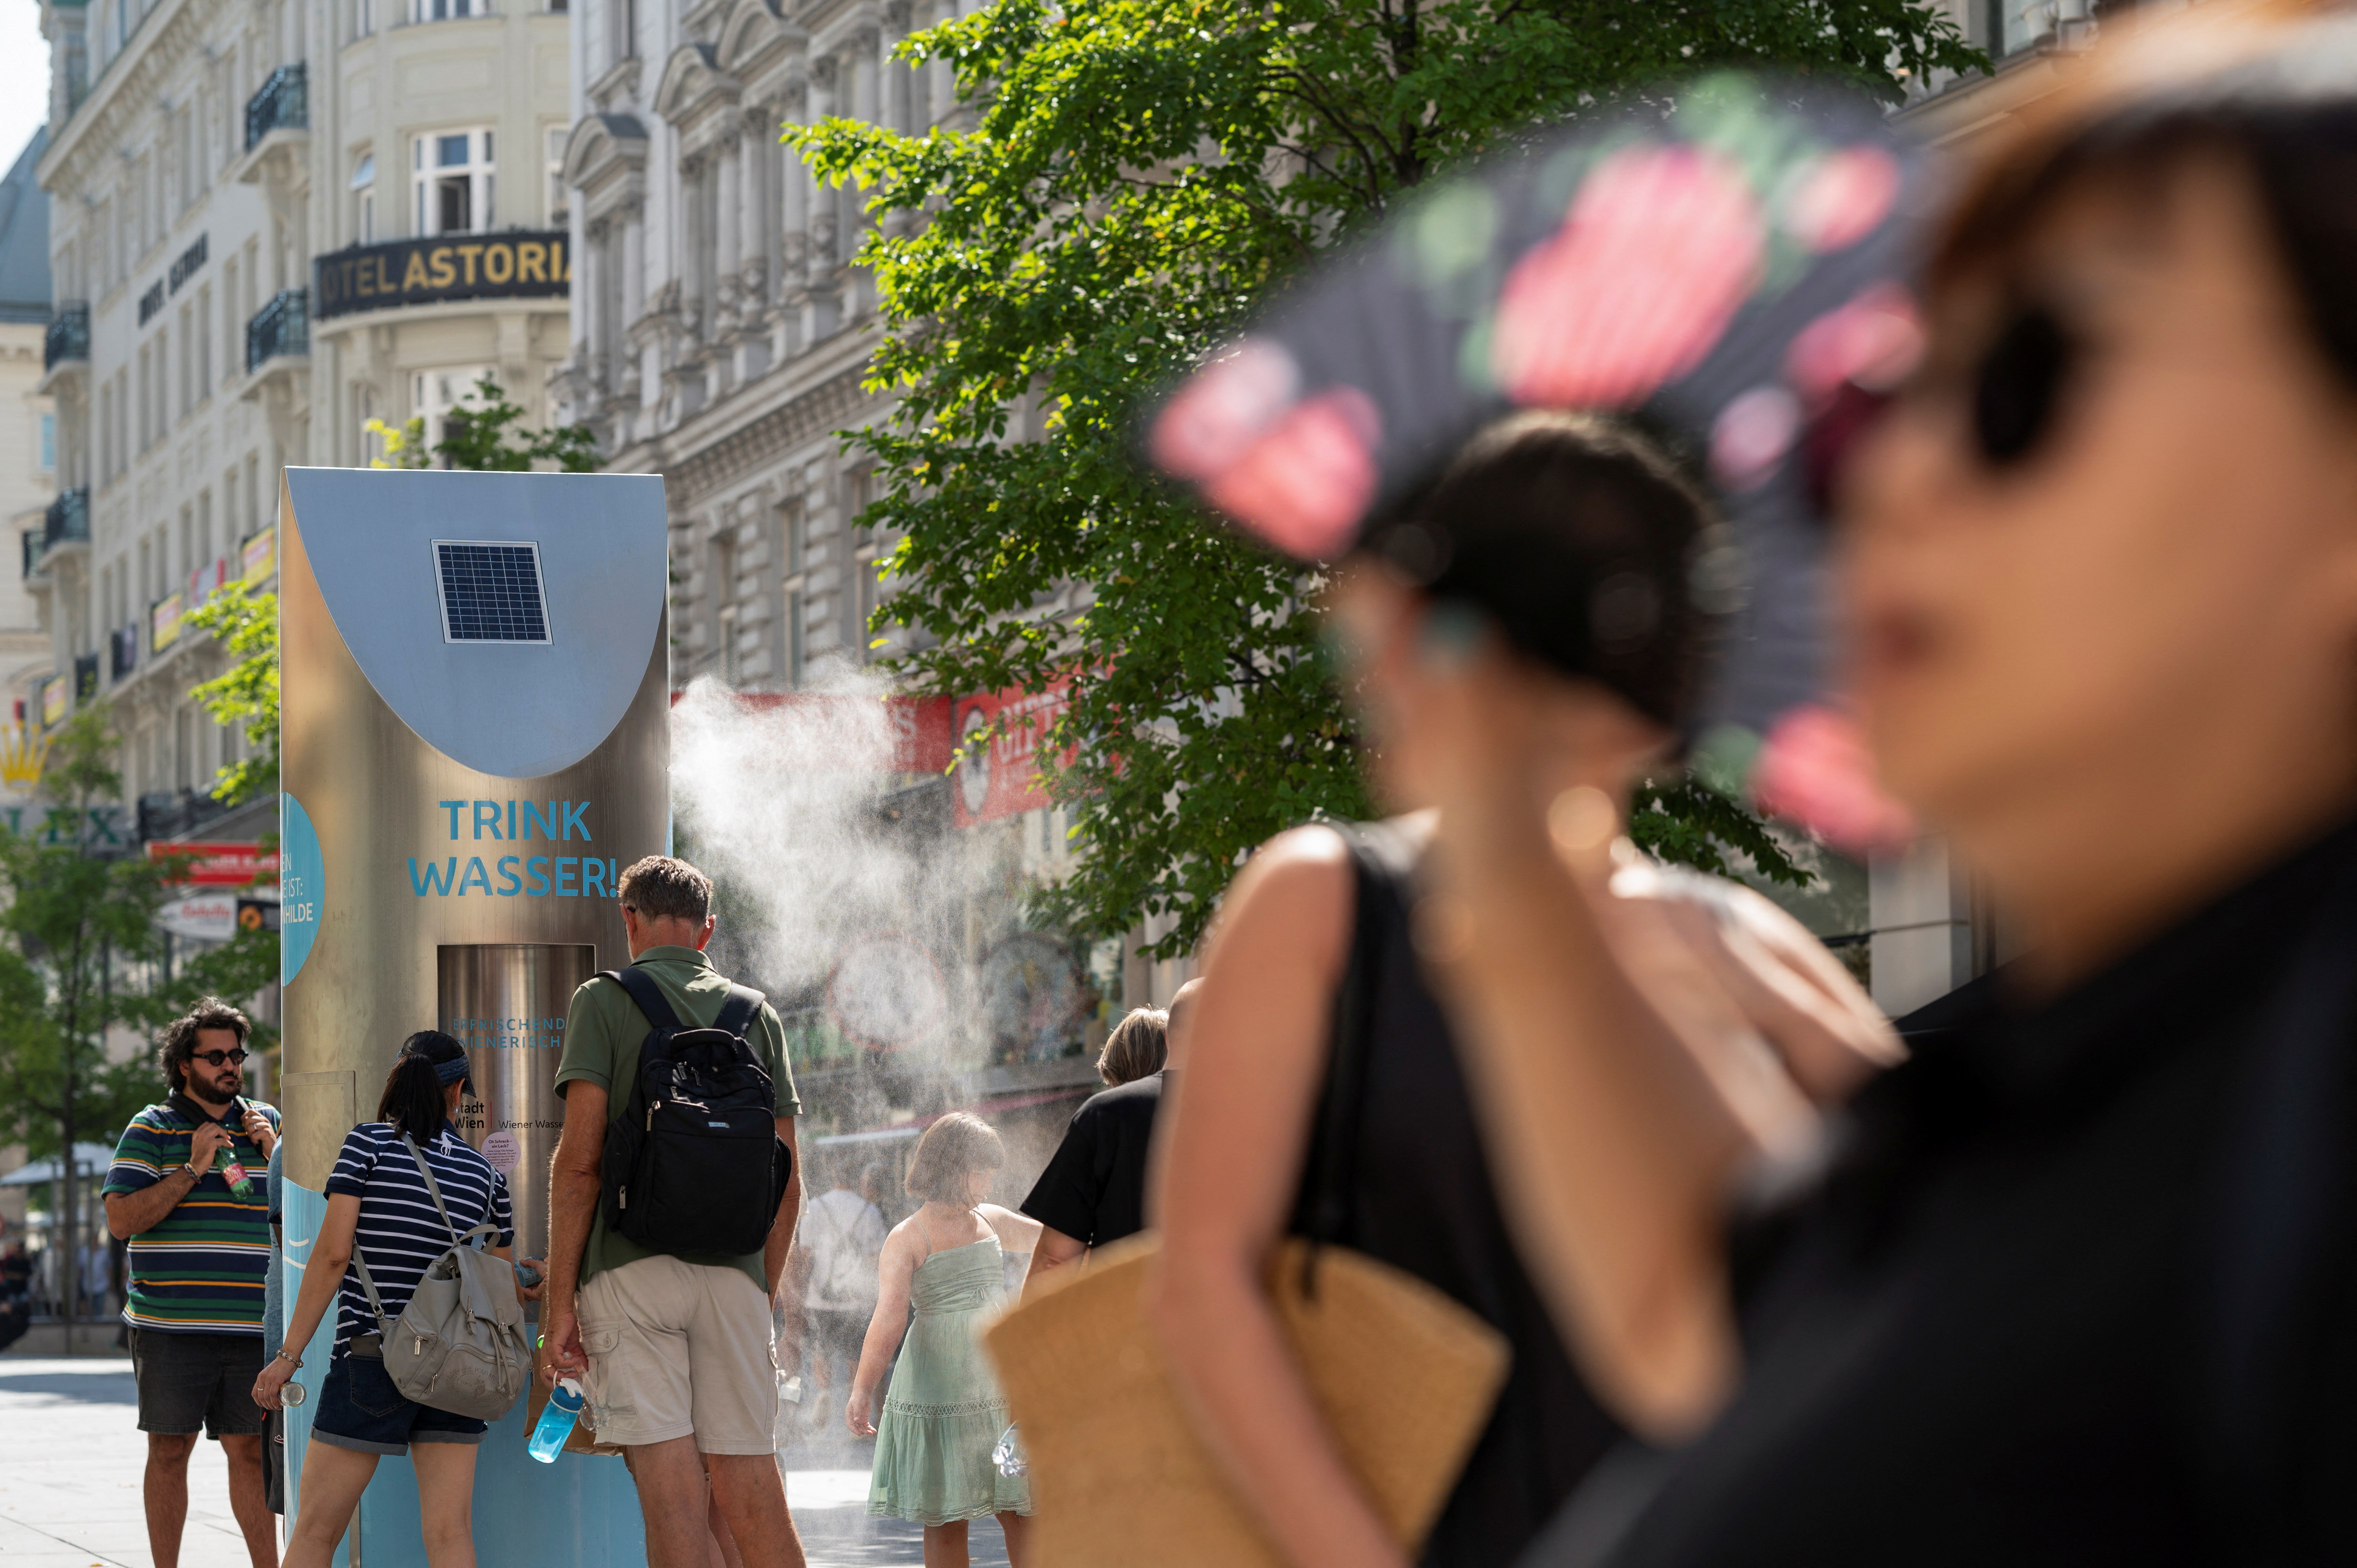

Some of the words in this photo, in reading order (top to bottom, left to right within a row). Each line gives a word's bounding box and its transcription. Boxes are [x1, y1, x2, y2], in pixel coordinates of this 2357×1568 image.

[321, 255, 397, 304] OTEL
[402, 240, 571, 292] ASTORI
[439, 800, 592, 841] TRINK
[407, 856, 617, 898] WASSER!
[288, 877, 303, 897] IST:
[453, 1018, 565, 1031] ERFRISCHEND
[457, 1035, 560, 1048] WIENERISCH
[460, 1101, 485, 1113] tadt
[455, 1116, 484, 1128] Wien
[498, 1120, 533, 1129] Wiener
[535, 1119, 563, 1128] Wasse
[475, 1367, 488, 1376] POLO
